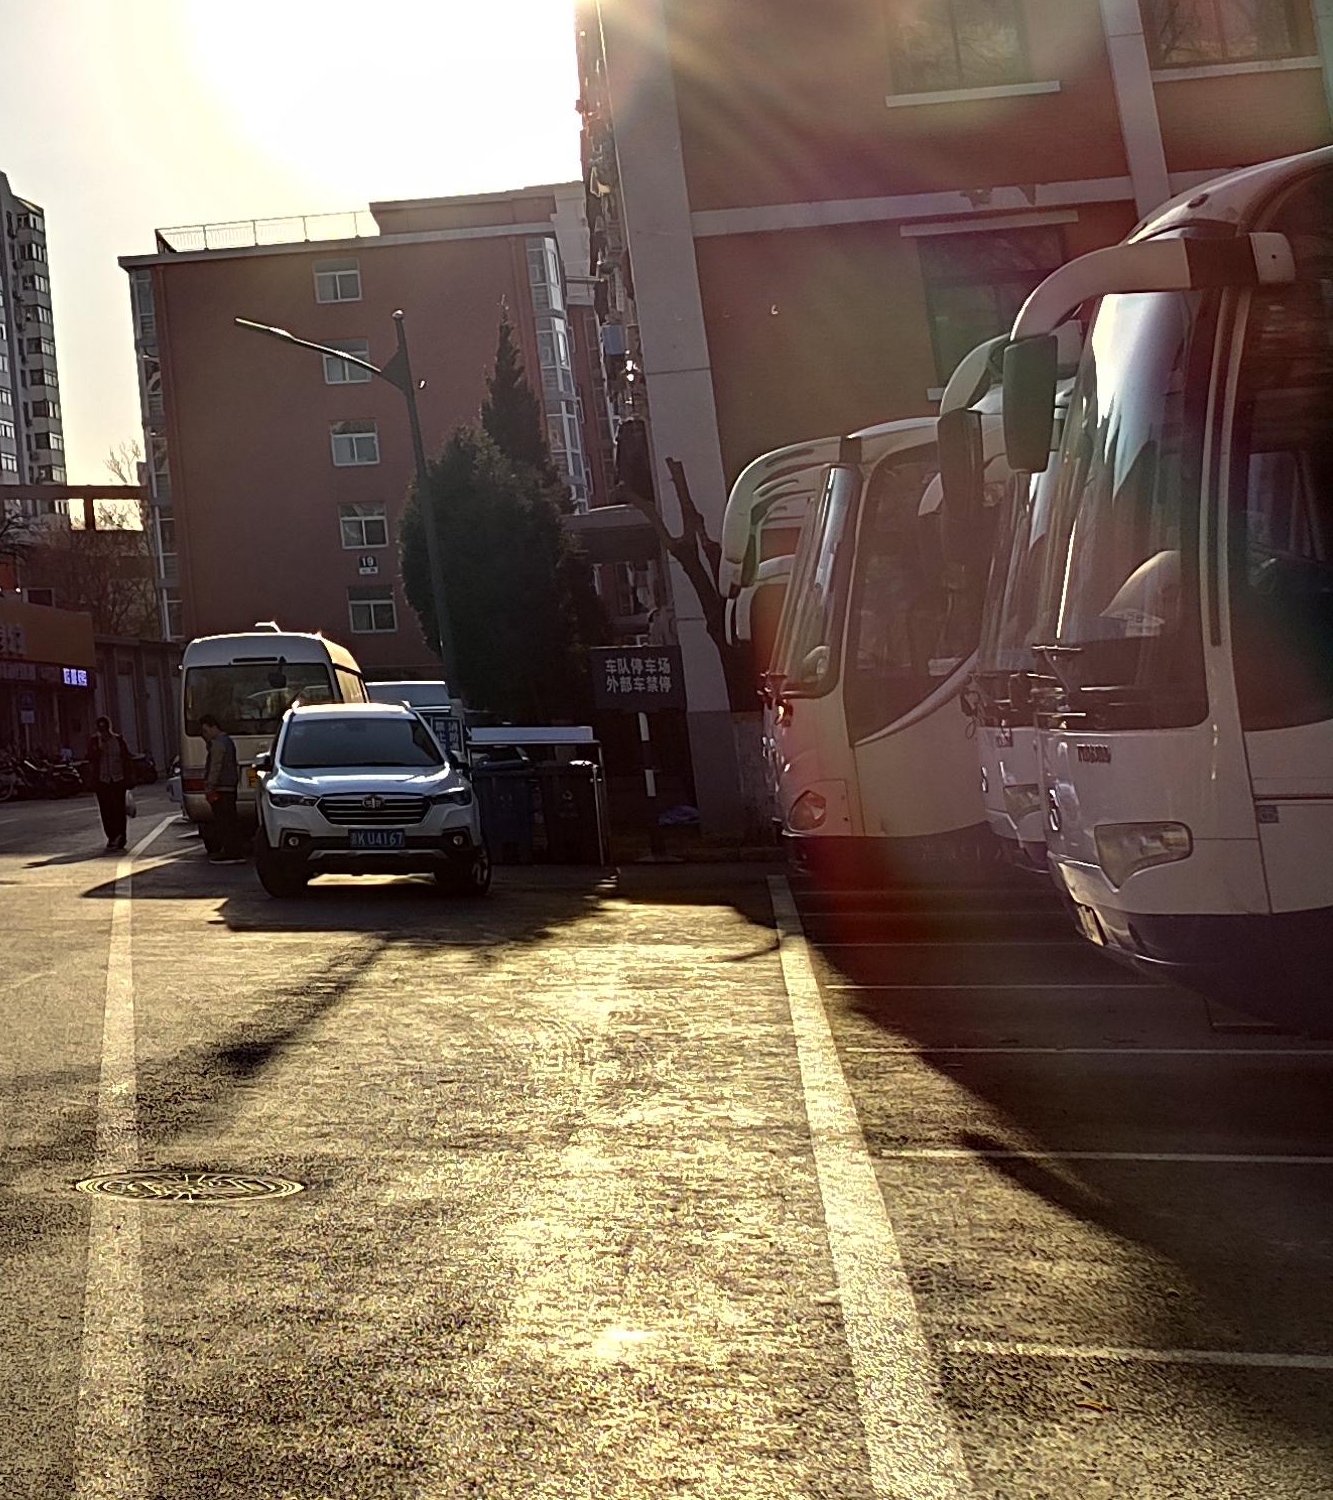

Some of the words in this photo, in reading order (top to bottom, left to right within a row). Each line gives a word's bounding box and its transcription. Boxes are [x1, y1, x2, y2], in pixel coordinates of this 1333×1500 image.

[362, 557, 374, 567] 19
[605, 657, 671, 675] 车队停车场
[606, 676, 672, 694] 外部车禁停
